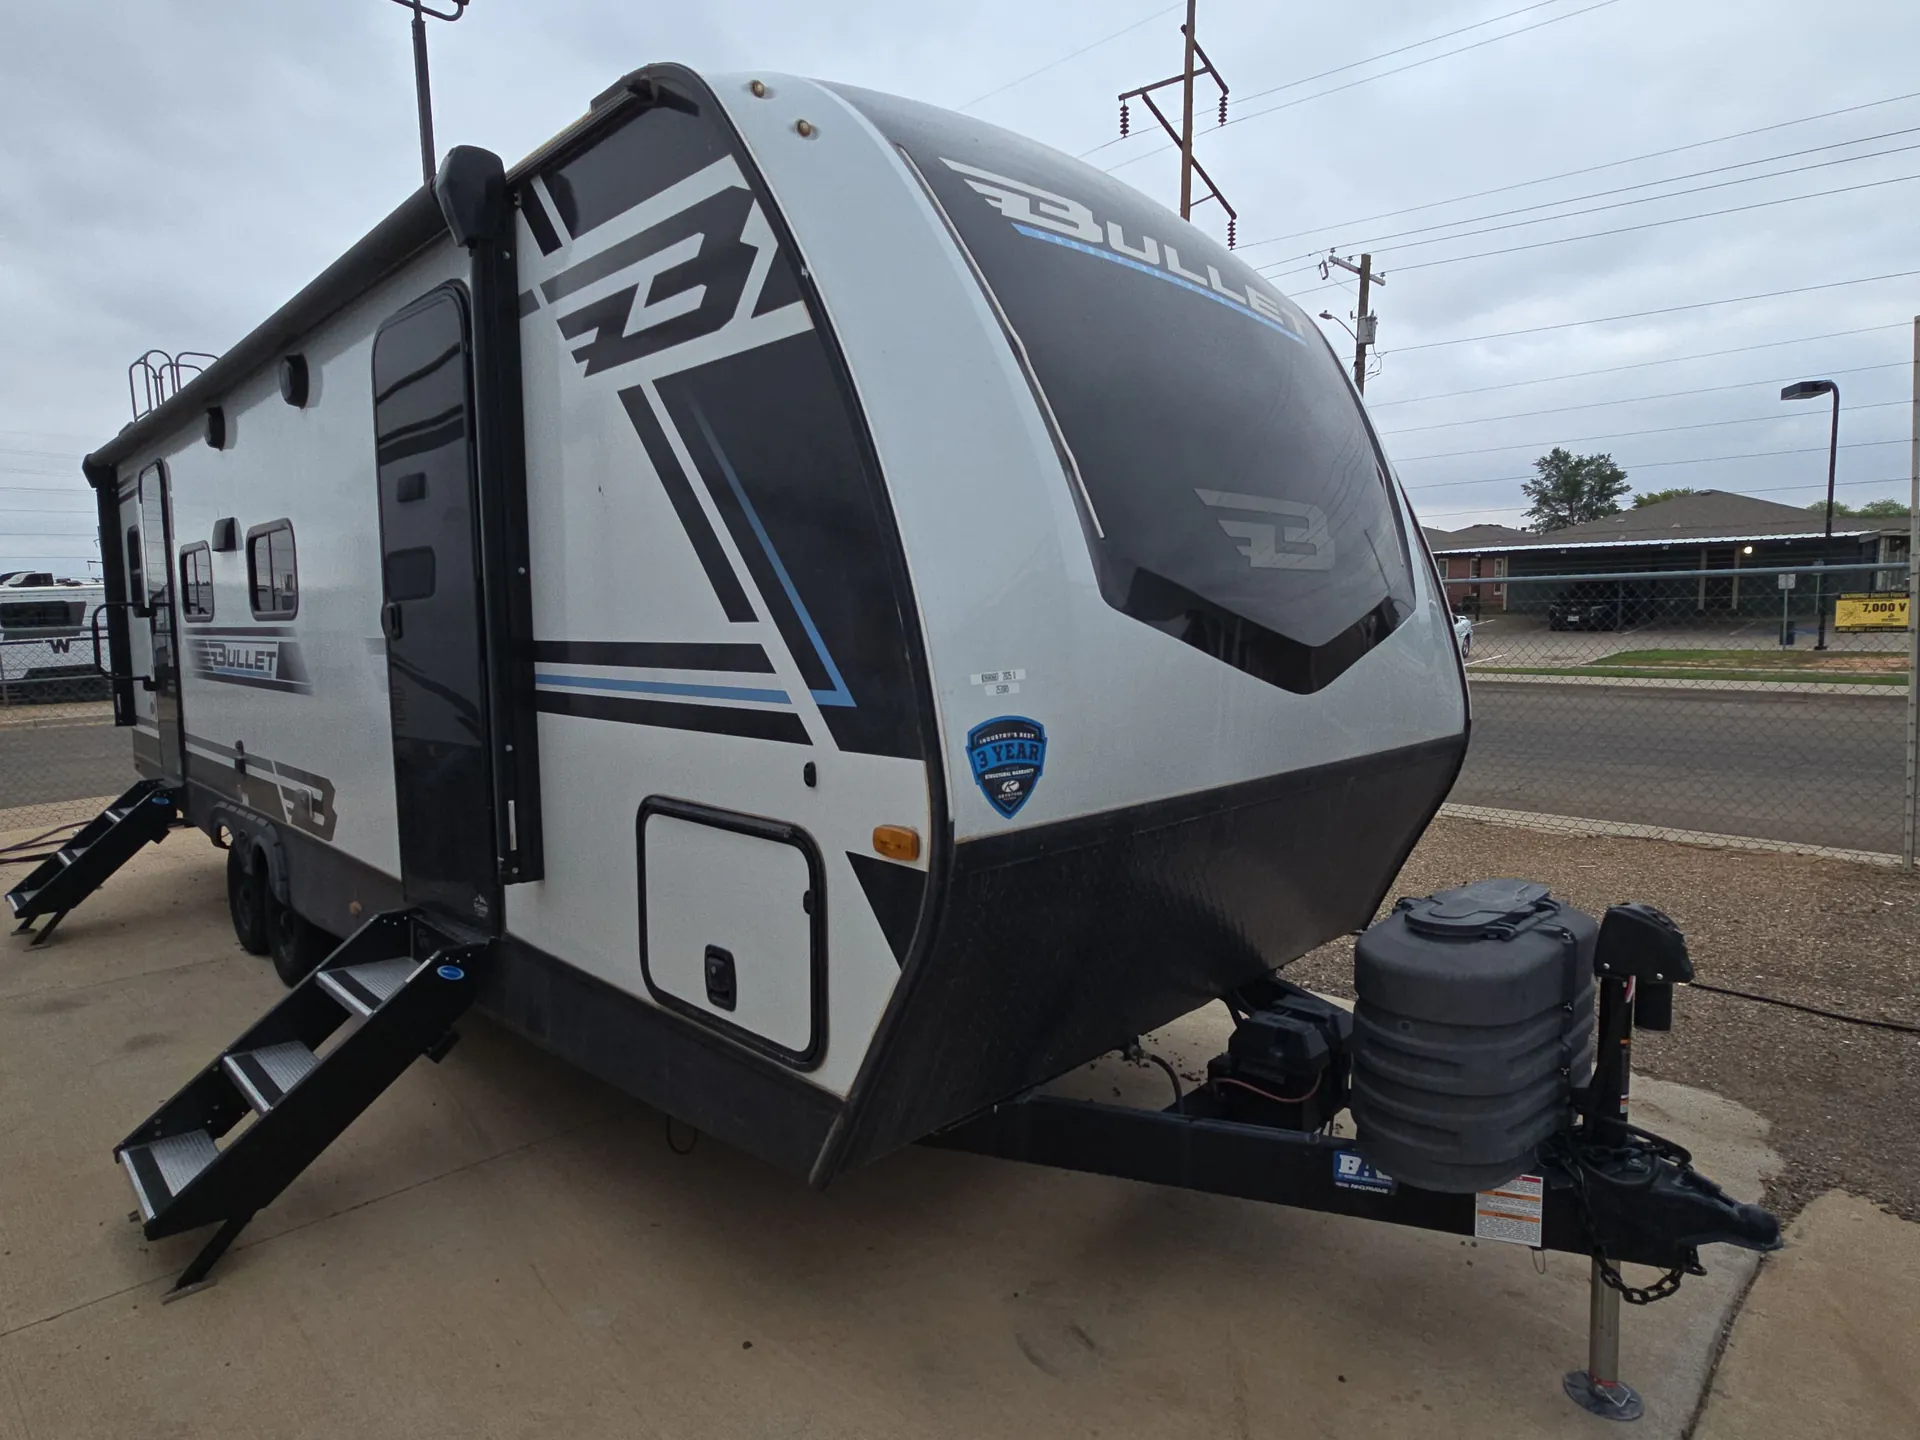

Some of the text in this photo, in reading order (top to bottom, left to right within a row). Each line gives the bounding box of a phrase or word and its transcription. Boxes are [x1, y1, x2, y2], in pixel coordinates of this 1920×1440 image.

[939, 157, 1307, 335] BULLET
[1862, 602, 1907, 614] 7,000 V
[207, 642, 277, 671] BULLET
[979, 732, 1018, 744] INDUSTRY'S
[976, 743, 1039, 769] 3 YEAR
